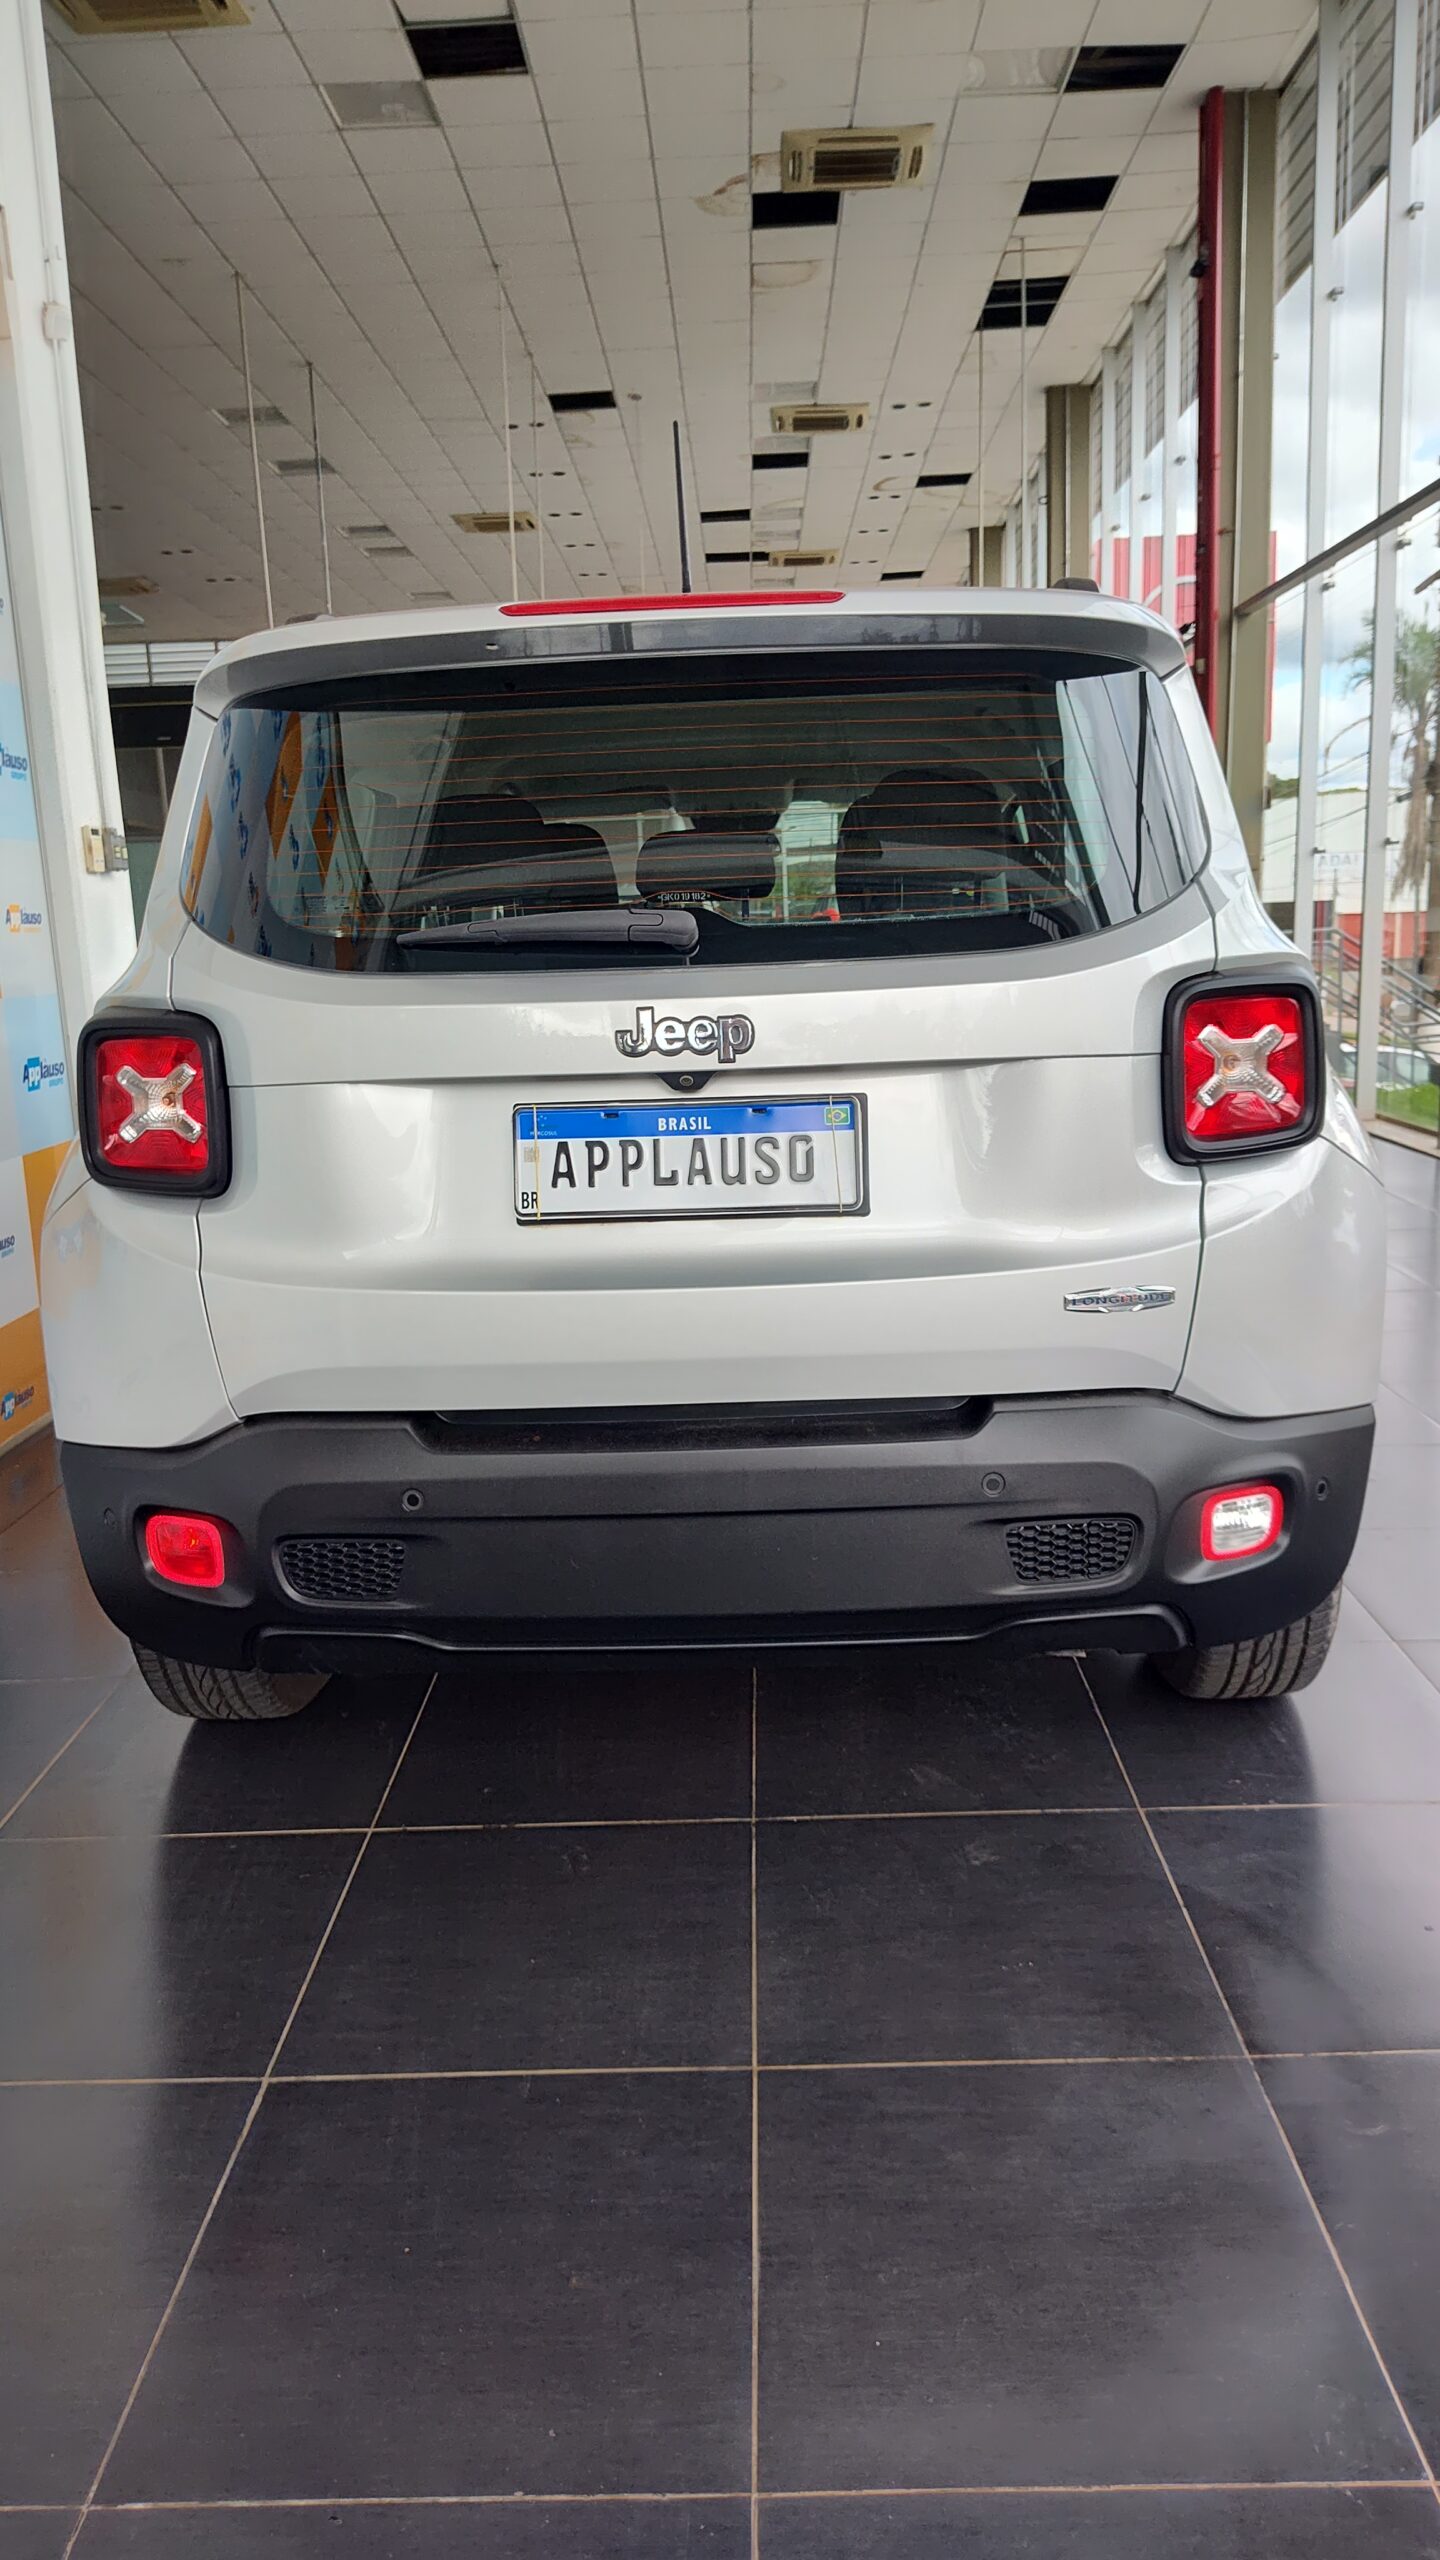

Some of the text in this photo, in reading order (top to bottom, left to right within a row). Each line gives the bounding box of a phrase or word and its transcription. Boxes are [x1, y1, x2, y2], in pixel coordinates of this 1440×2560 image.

[614, 1006, 756, 1063] Jeep
[657, 1116, 712, 1131] BRASIL
[550, 1135, 815, 1189] APPLAUSO
[521, 1191, 539, 1209] BR
[1071, 1292, 1170, 1306] LONGITUDE
